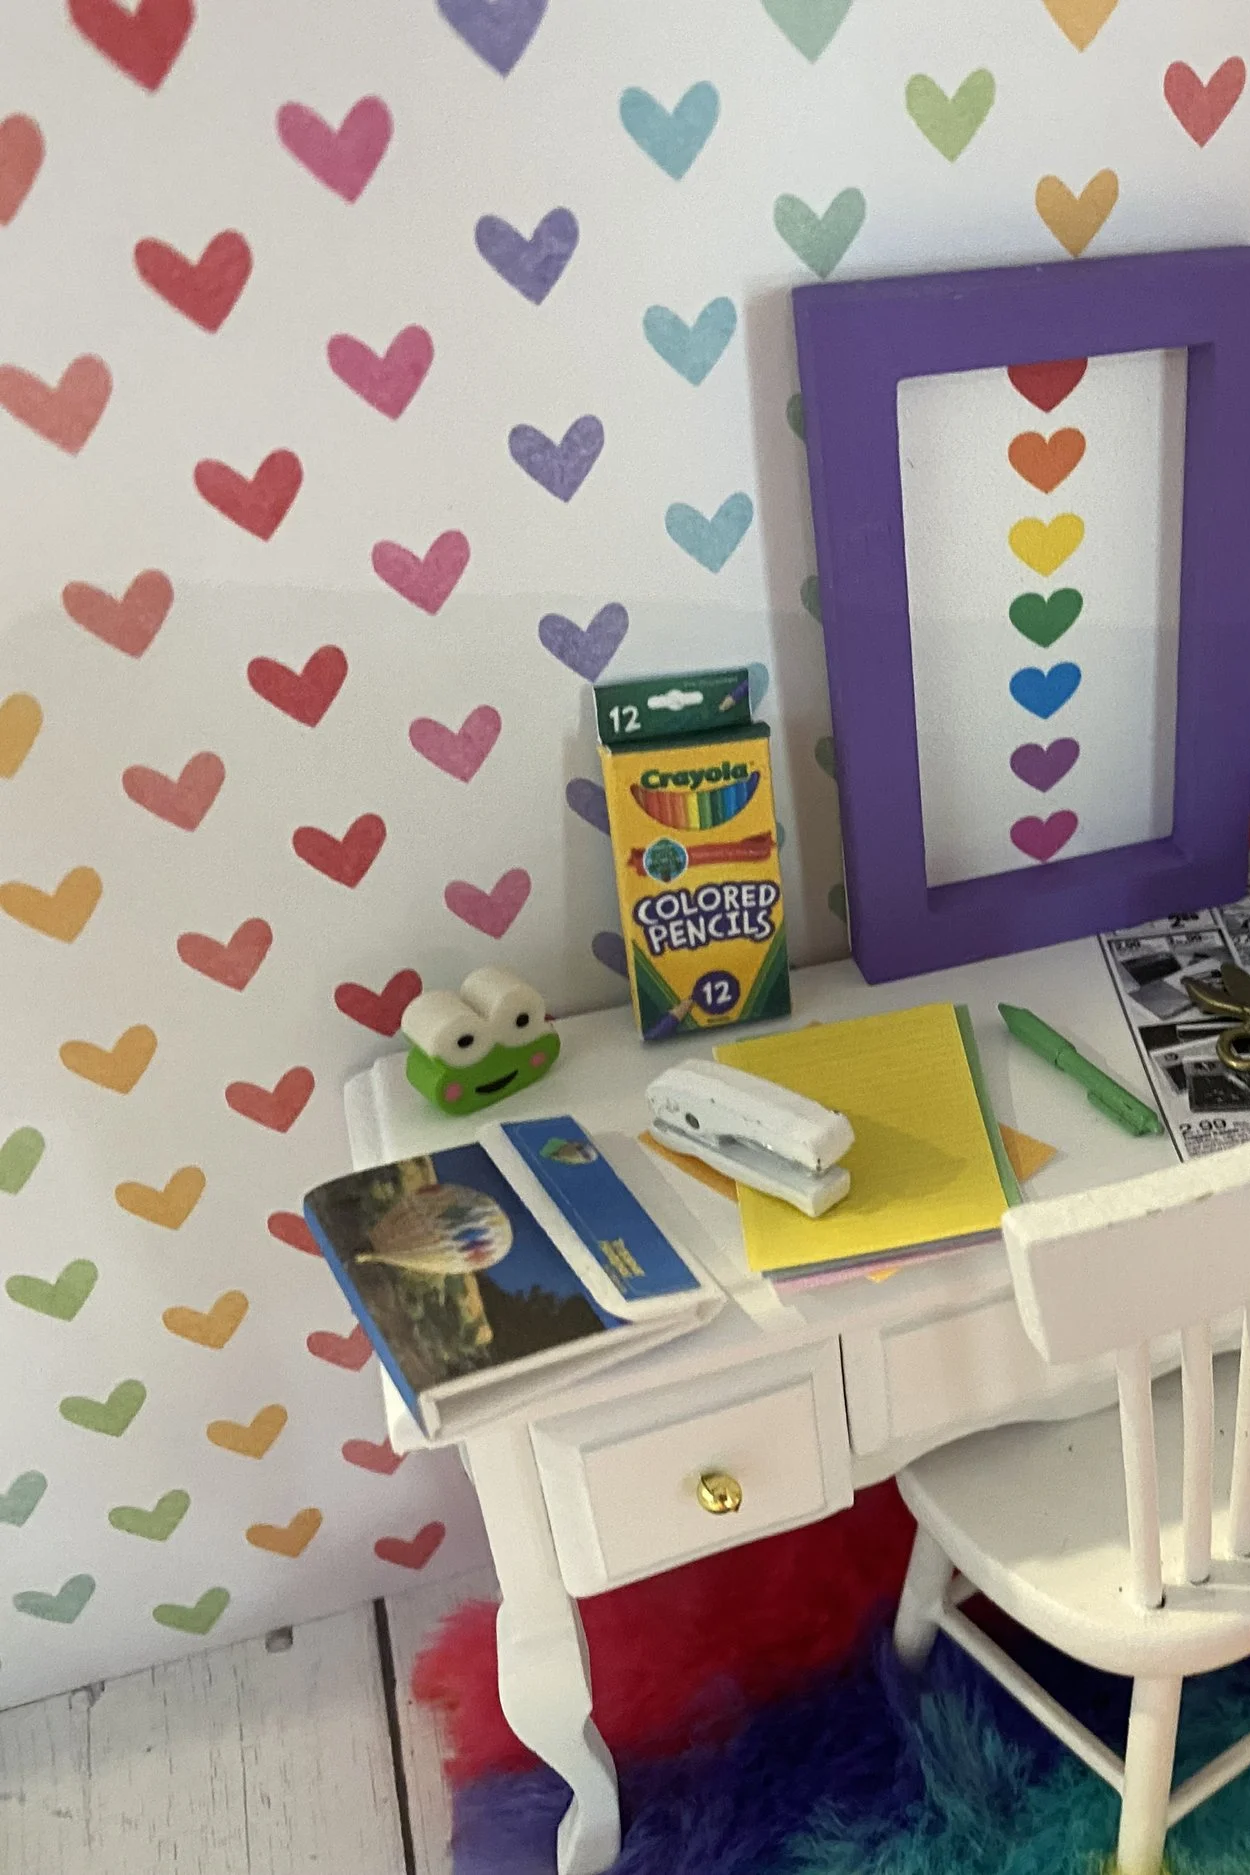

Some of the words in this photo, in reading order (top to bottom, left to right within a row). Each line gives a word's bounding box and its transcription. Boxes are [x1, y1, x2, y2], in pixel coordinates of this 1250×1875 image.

[609, 705, 642, 733] 12
[640, 761, 749, 790] Crayola
[636, 883, 778, 926] COLORED
[649, 909, 773, 954] PENCILS
[702, 981, 733, 1005] 12
